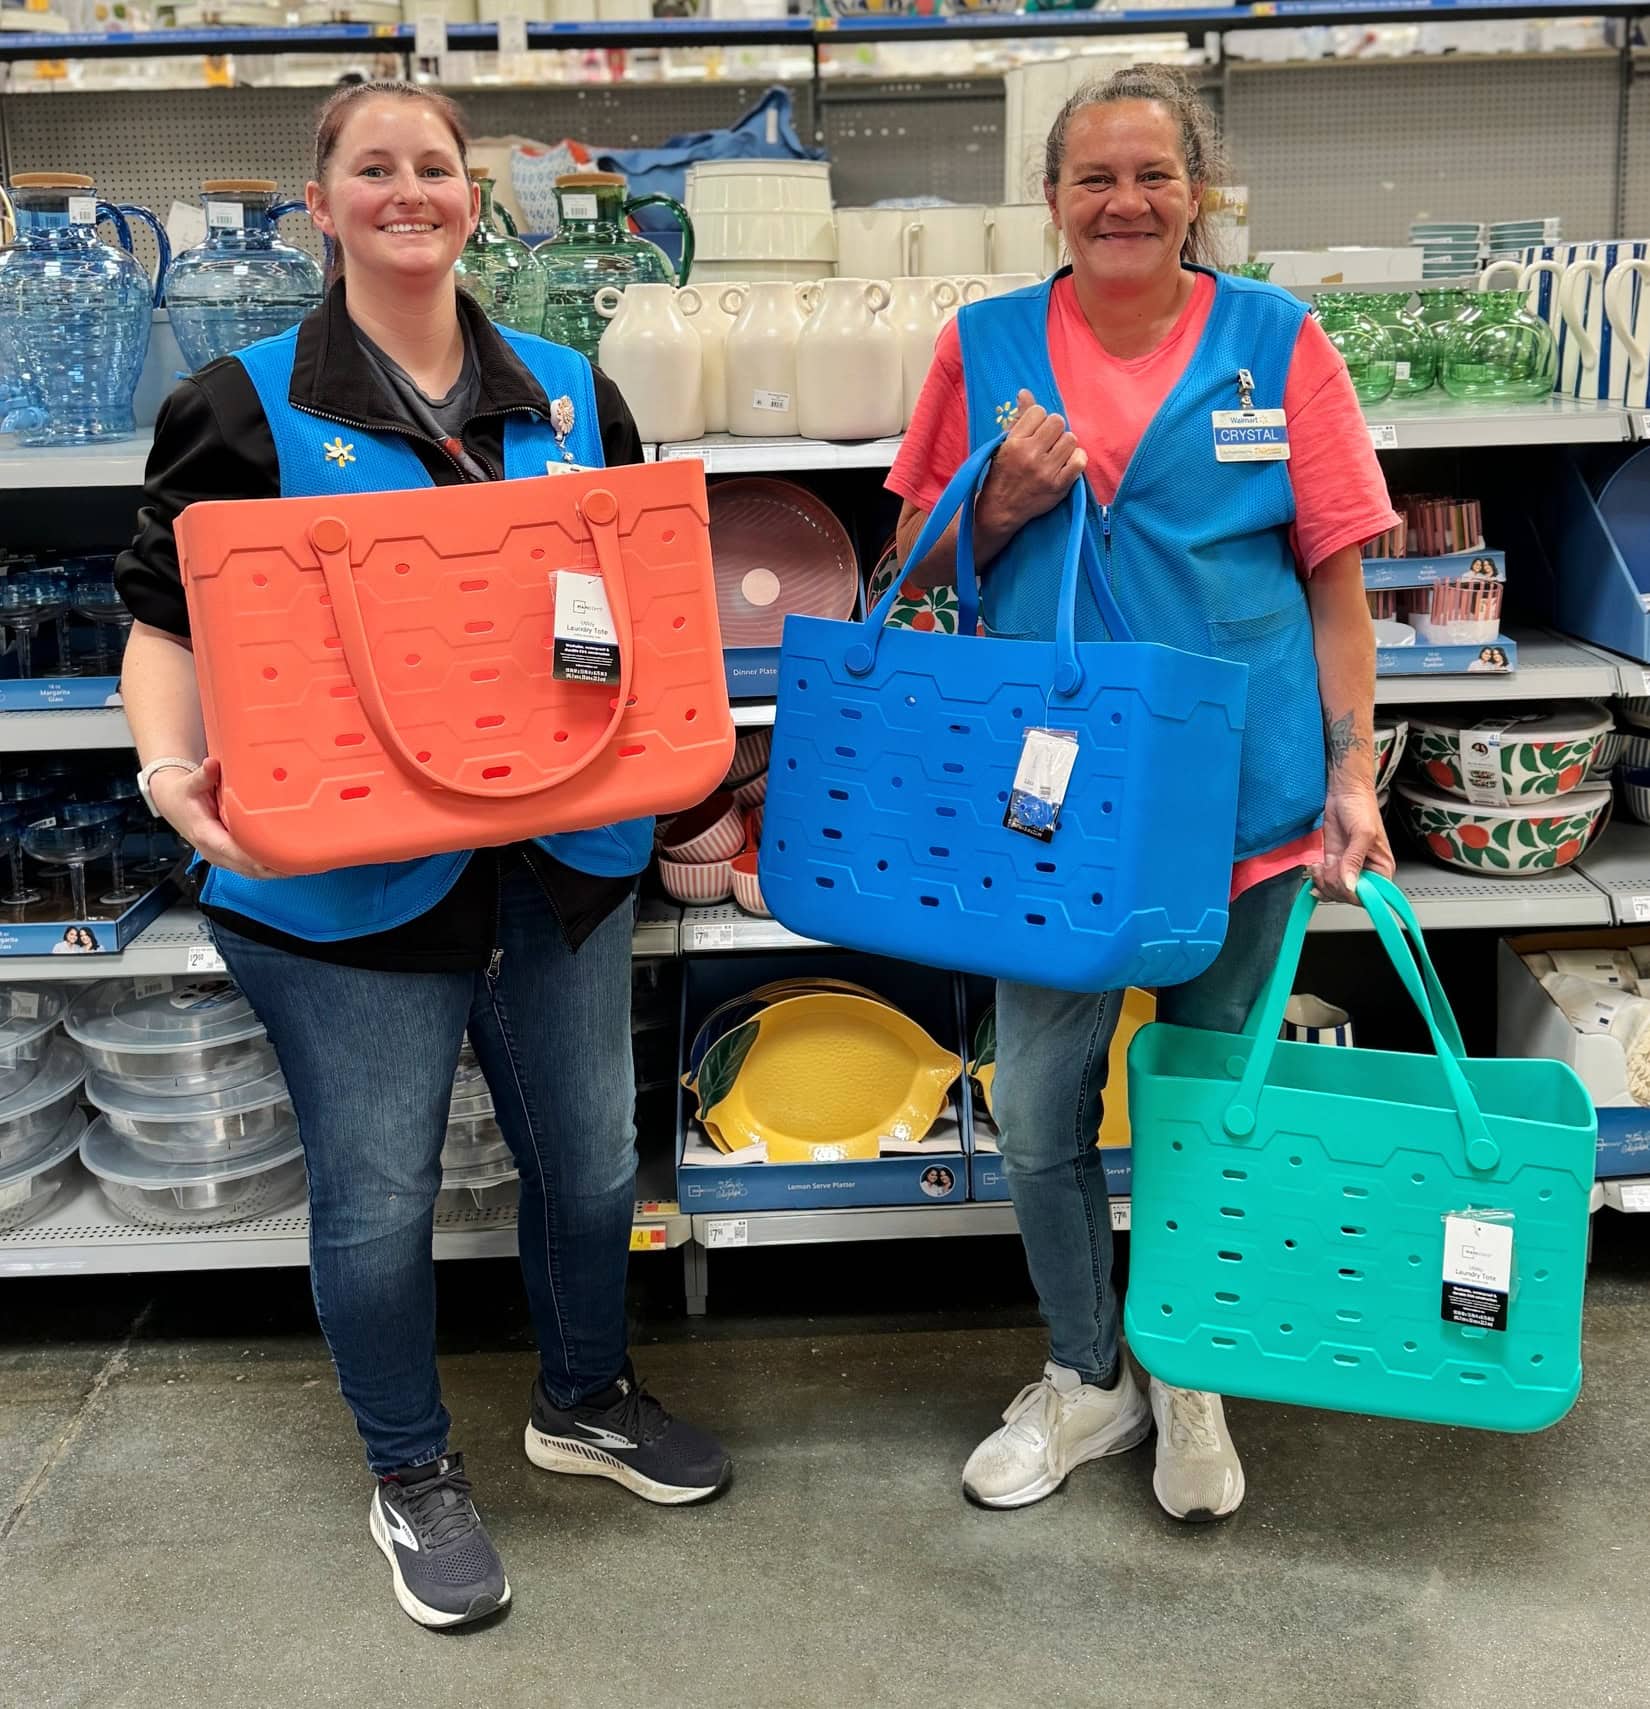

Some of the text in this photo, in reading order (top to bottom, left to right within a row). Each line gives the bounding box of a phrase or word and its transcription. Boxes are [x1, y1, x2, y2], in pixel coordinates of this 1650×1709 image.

[1230, 416, 1259, 425] Walmart
[1220, 428, 1279, 442] CRYSTAL
[566, 624, 609, 635] Laundry Tote
[733, 668, 758, 676] Dinner
[40, 689, 71, 697] Margarita
[1106, 1168, 1125, 1176] Serve
[812, 1182, 832, 1190] Serve
[832, 1181, 856, 1189] Platter
[1455, 1268, 1481, 1280] Laundry
[1482, 1272, 1497, 1281] Tote
